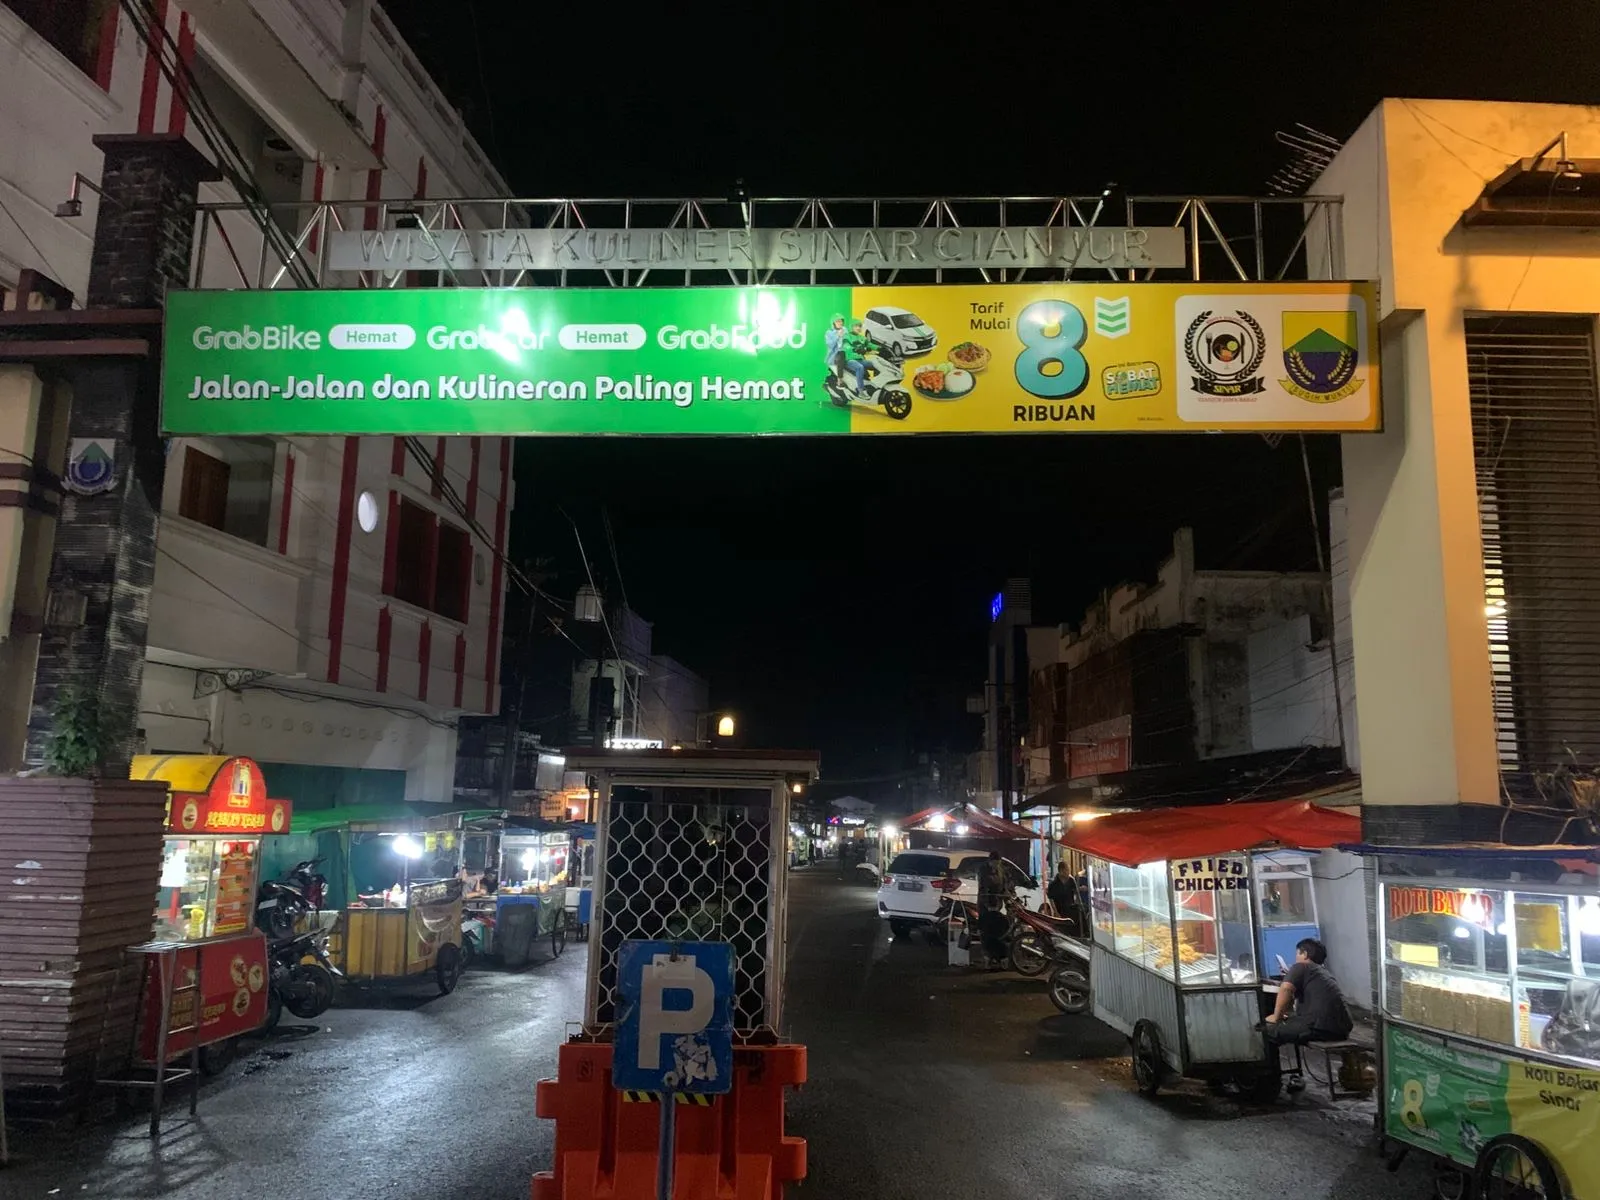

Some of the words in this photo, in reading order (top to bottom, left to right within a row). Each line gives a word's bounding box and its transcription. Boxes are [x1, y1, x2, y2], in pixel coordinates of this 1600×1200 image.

[360, 227, 534, 263] WISATA
[552, 228, 753, 263] KULINER
[777, 228, 924, 263] SINAR
[933, 228, 1153, 264] CIANJUR
[970, 302, 1004, 315] Tarif
[970, 318, 1011, 331] Mulai
[192, 324, 321, 350] GrabBike
[346, 330, 398, 344] Hemat
[576, 330, 629, 344] Hemat
[1015, 299, 1090, 400] 8
[188, 374, 366, 400] Jalan-Jalan
[372, 374, 431, 400] dan
[438, 374, 588, 401] Kulineran
[595, 375, 693, 408] Paling
[701, 376, 805, 400] Hemat
[1213, 385, 1242, 394] SINAR
[1013, 404, 1096, 422] RIBUAN
[1178, 859, 1243, 877] FRIED
[1174, 877, 1248, 891] CHICKEN
[1390, 887, 1429, 922] ROTI
[637, 964, 715, 1070] P
[1523, 1063, 1554, 1085] Roti
[1402, 1079, 1427, 1131] 8
[1539, 1089, 1582, 1112] Sinar
